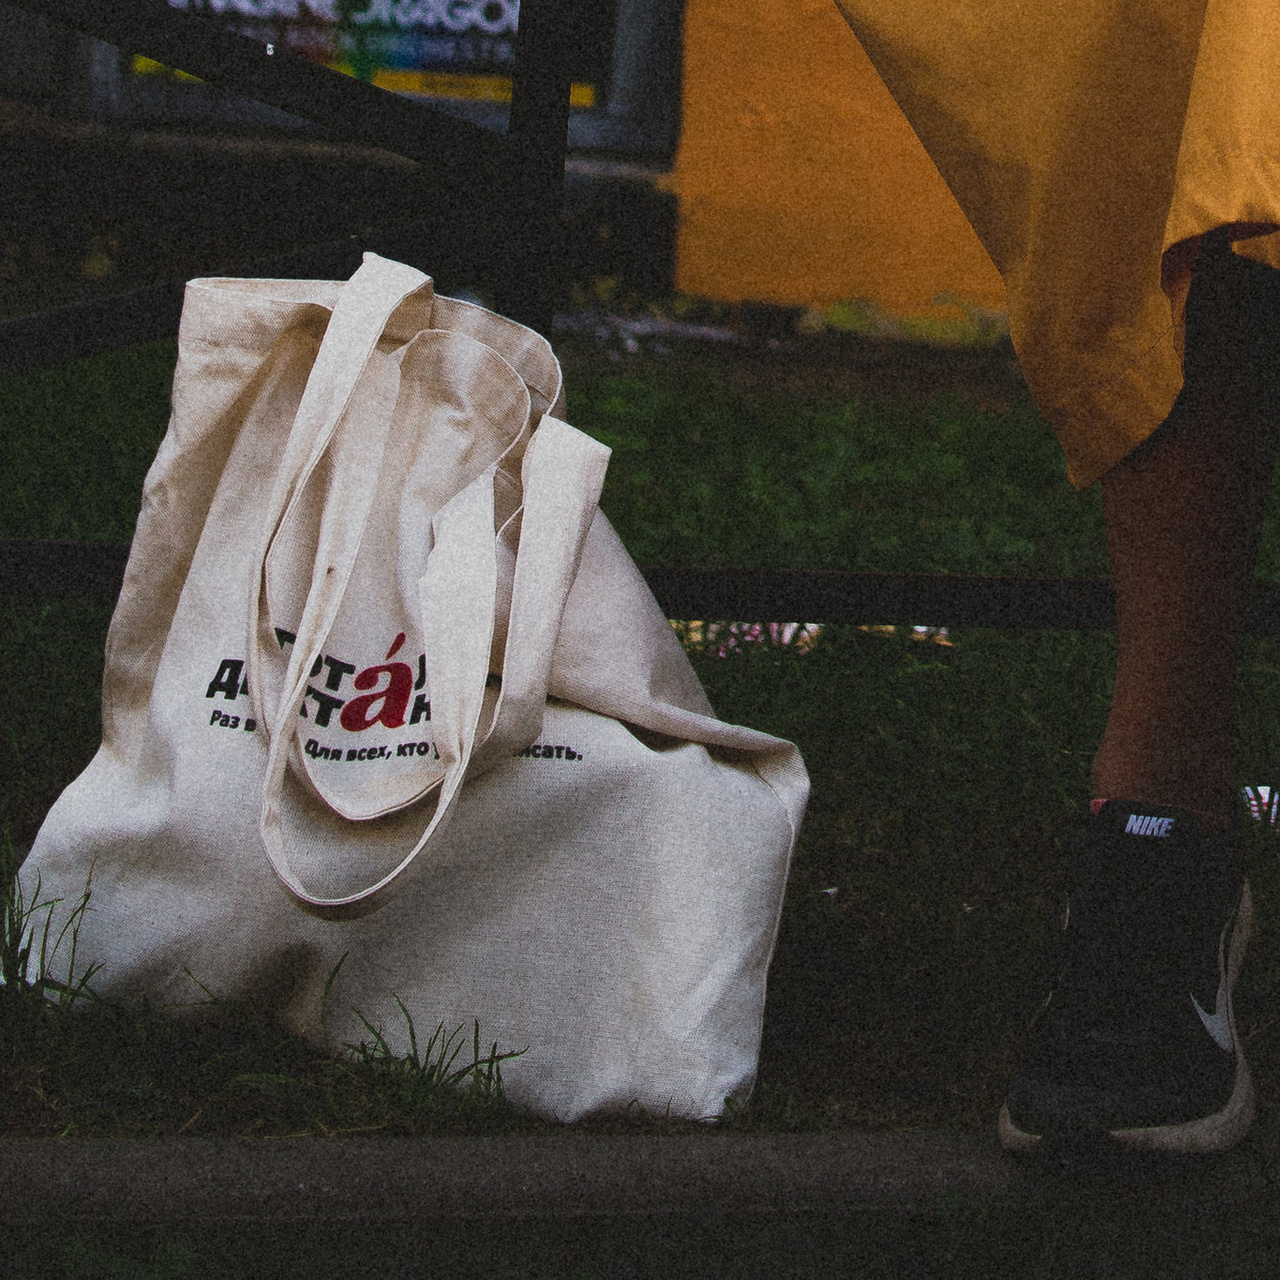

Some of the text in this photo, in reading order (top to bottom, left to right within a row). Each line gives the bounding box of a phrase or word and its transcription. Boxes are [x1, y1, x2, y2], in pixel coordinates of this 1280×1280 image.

[209, 709, 241, 730] Раз
[304, 738, 342, 761] Для
[346, 744, 393, 761] всех,
[396, 741, 430, 758] кто
[513, 744, 584, 761] исать.
[1124, 814, 1176, 838] NIKE
